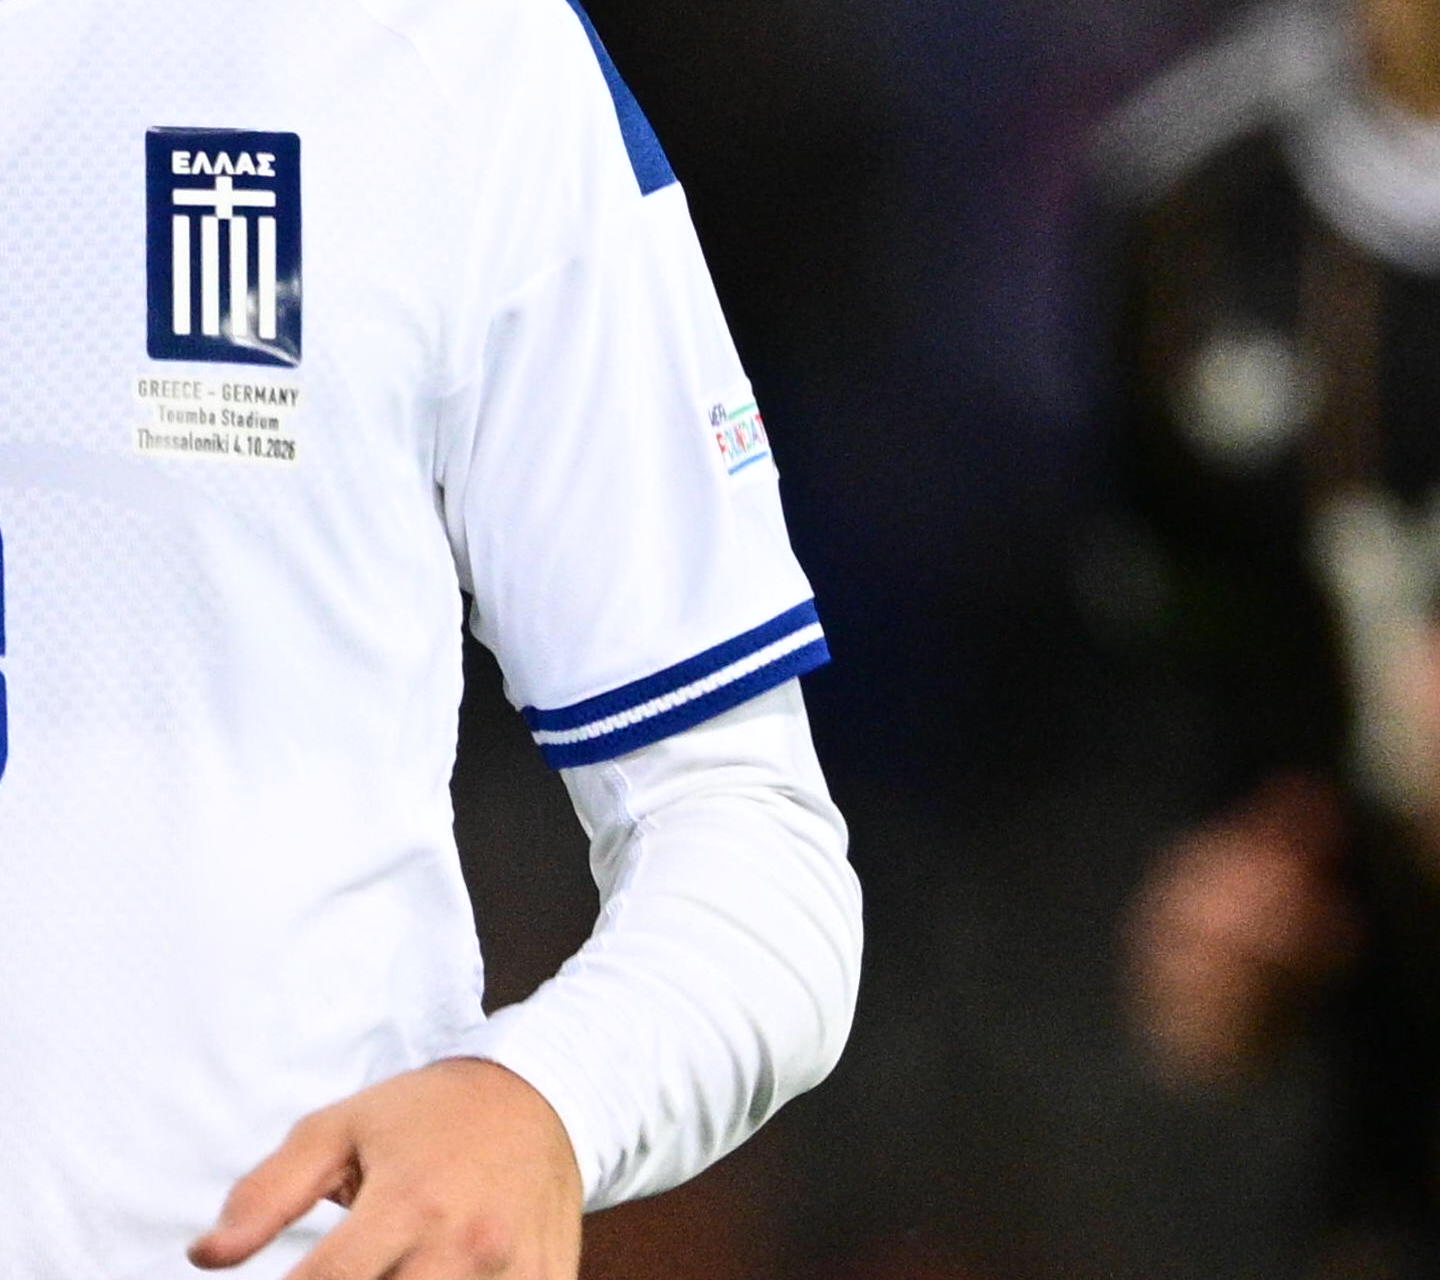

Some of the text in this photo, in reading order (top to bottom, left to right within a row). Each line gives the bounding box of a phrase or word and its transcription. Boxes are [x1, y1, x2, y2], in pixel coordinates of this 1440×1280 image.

[171, 149, 276, 177] ΕΛΛΑΣ
[138, 380, 202, 400] GREECE
[222, 383, 298, 407] GERMANY
[159, 404, 279, 430] Toumba Stadium
[137, 428, 296, 460] Thessaloniki 4.10.2026
[716, 414, 769, 462] FOUNDAT
